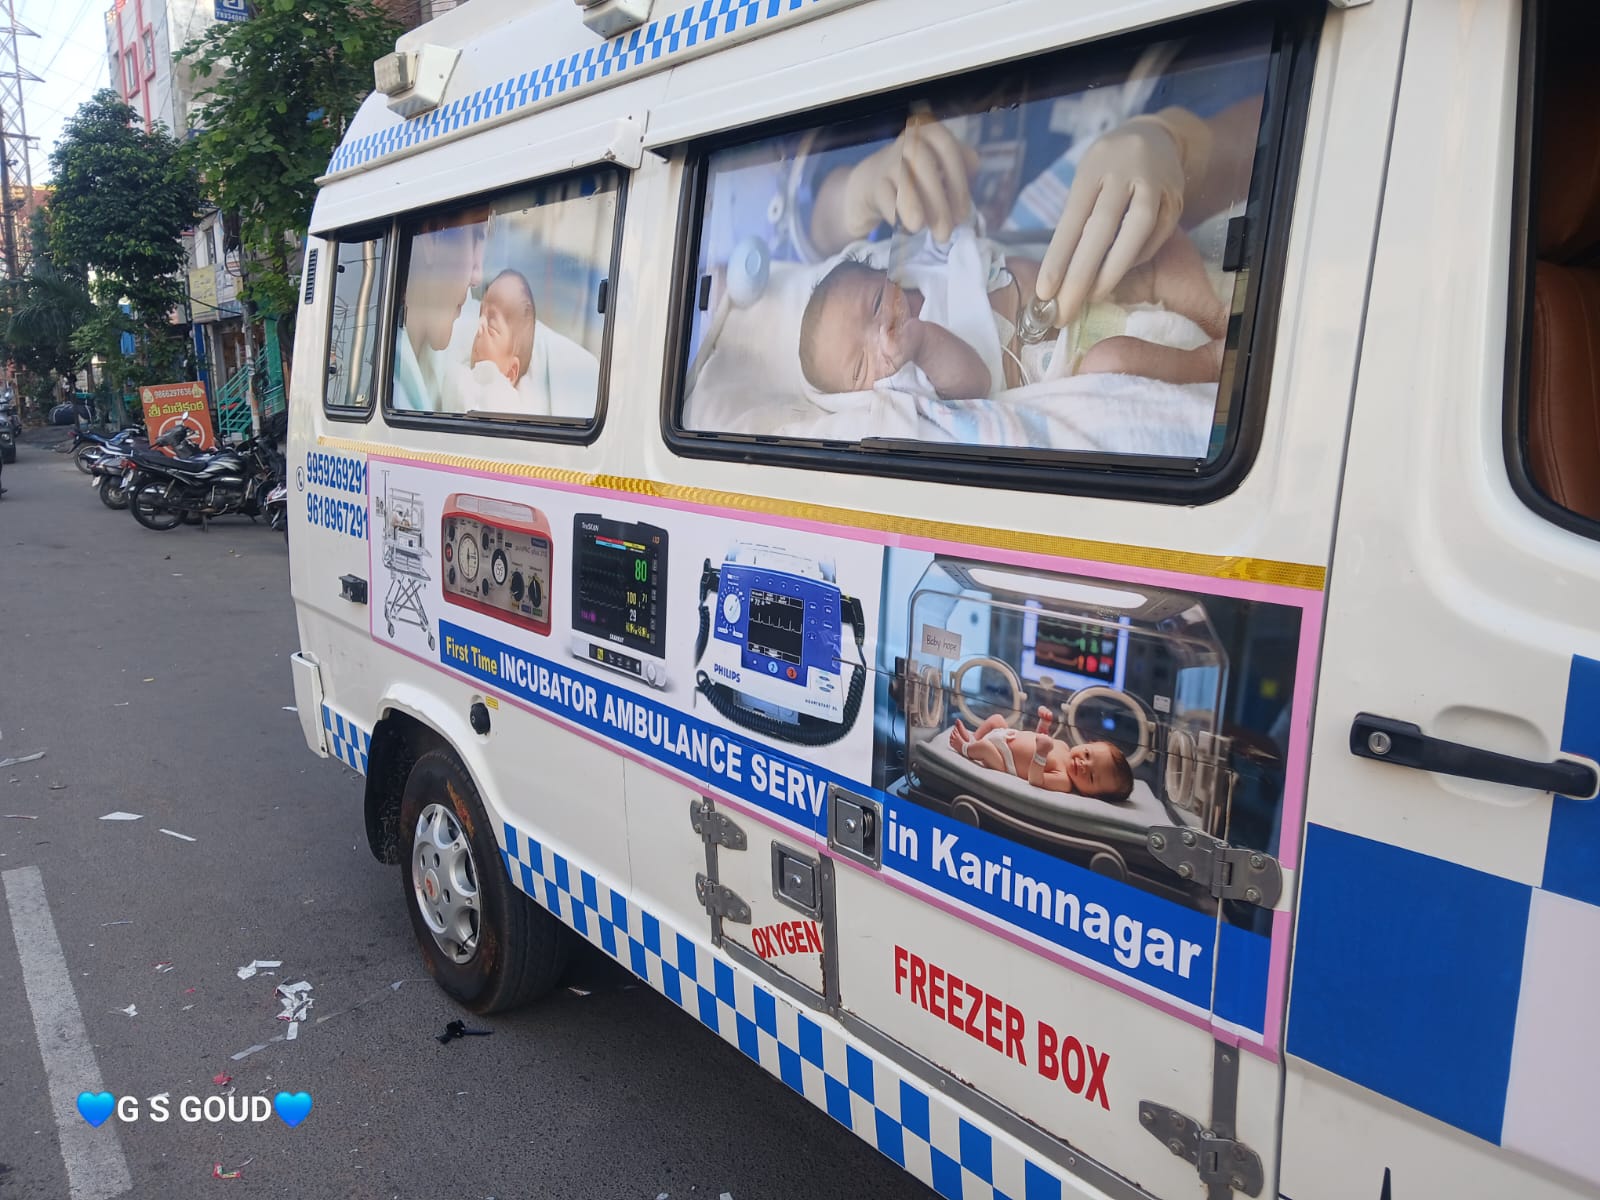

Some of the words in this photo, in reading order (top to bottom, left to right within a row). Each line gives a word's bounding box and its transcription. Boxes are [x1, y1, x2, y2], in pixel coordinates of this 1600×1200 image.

[306, 451, 368, 495] 9959269291
[306, 492, 369, 540] 9618967291
[634, 559, 647, 582] 80
[714, 663, 741, 683] PHILIPS
[446, 636, 469, 664] First
[471, 646, 497, 675] Time
[500, 652, 598, 718] INCUBATOR
[603, 696, 743, 783] AMBULANCE
[751, 754, 827, 817] SERV
[888, 809, 918, 862] in
[931, 827, 1202, 979] Karimnagar
[751, 920, 823, 959] OXYGEN
[894, 944, 1027, 1066] FREEZER
[1037, 1021, 1111, 1111] BOX
